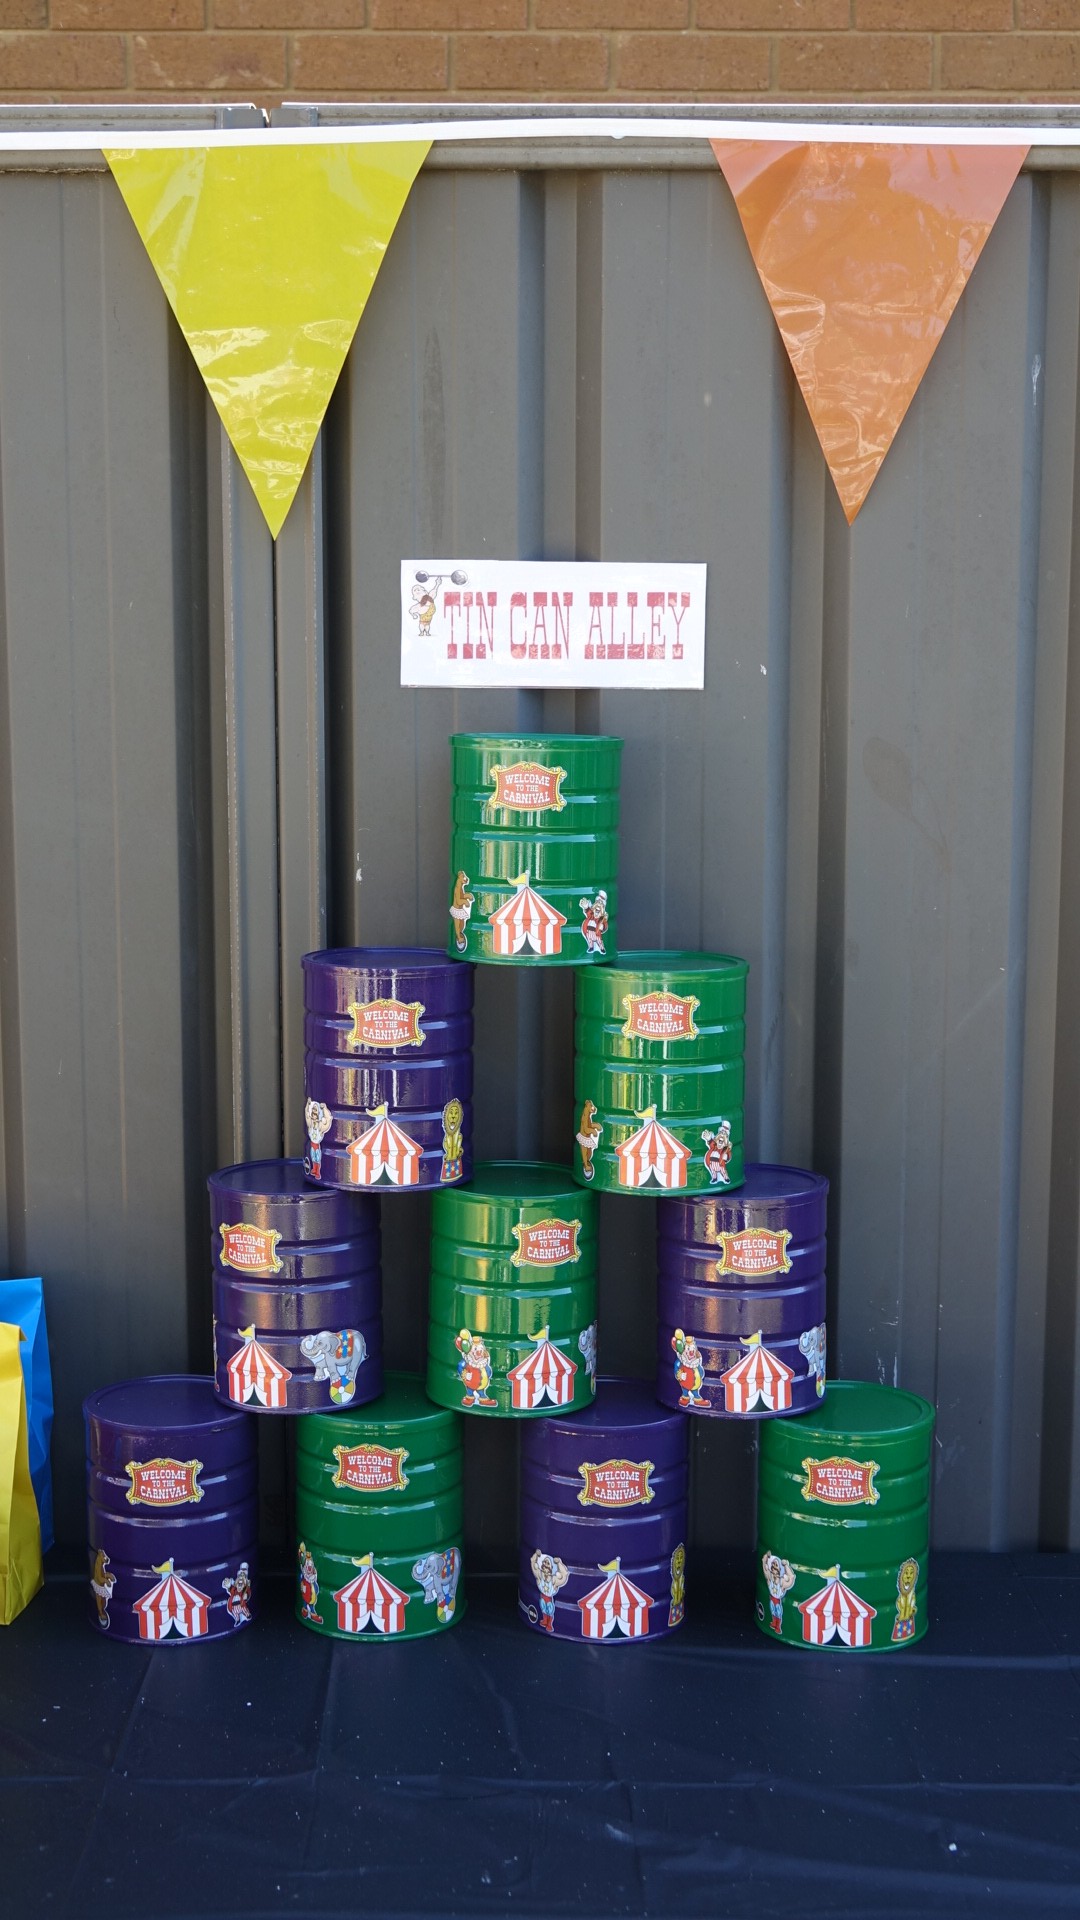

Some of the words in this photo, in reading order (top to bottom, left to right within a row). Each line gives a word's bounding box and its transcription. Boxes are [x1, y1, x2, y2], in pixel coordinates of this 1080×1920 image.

[443, 591, 498, 660] TIN
[509, 591, 574, 660] CAN
[584, 591, 691, 660] ALLEY
[505, 773, 550, 786] WELCOME
[503, 789, 551, 804] CARNIVAL
[363, 1010, 409, 1021] WELCOME
[638, 1003, 684, 1016] WELCOME
[637, 1019, 684, 1033] CARNIVAL
[362, 1027, 410, 1040] CARNIVAL
[228, 1234, 266, 1248] WELCOME
[528, 1229, 570, 1241] WELCOME
[245, 1244, 256, 1253] THE
[540, 1240, 548, 1248] TO
[733, 1239, 778, 1250] WELCOME
[228, 1248, 267, 1264] CARNIVAL
[527, 1244, 570, 1259] CARNIVAL
[731, 1255, 778, 1268] CARNIVAL
[348, 1455, 393, 1467] WELCOME
[140, 1470, 186, 1480] WELCOME
[346, 1470, 393, 1484] CARNIVAL
[595, 1470, 640, 1482] WELCOME
[817, 1468, 863, 1480] WELCOME
[838, 1478, 852, 1486] THE
[140, 1485, 187, 1499] CARNIVAL
[594, 1486, 640, 1500] CARNIVAL
[816, 1482, 864, 1498] CARNIVAL
